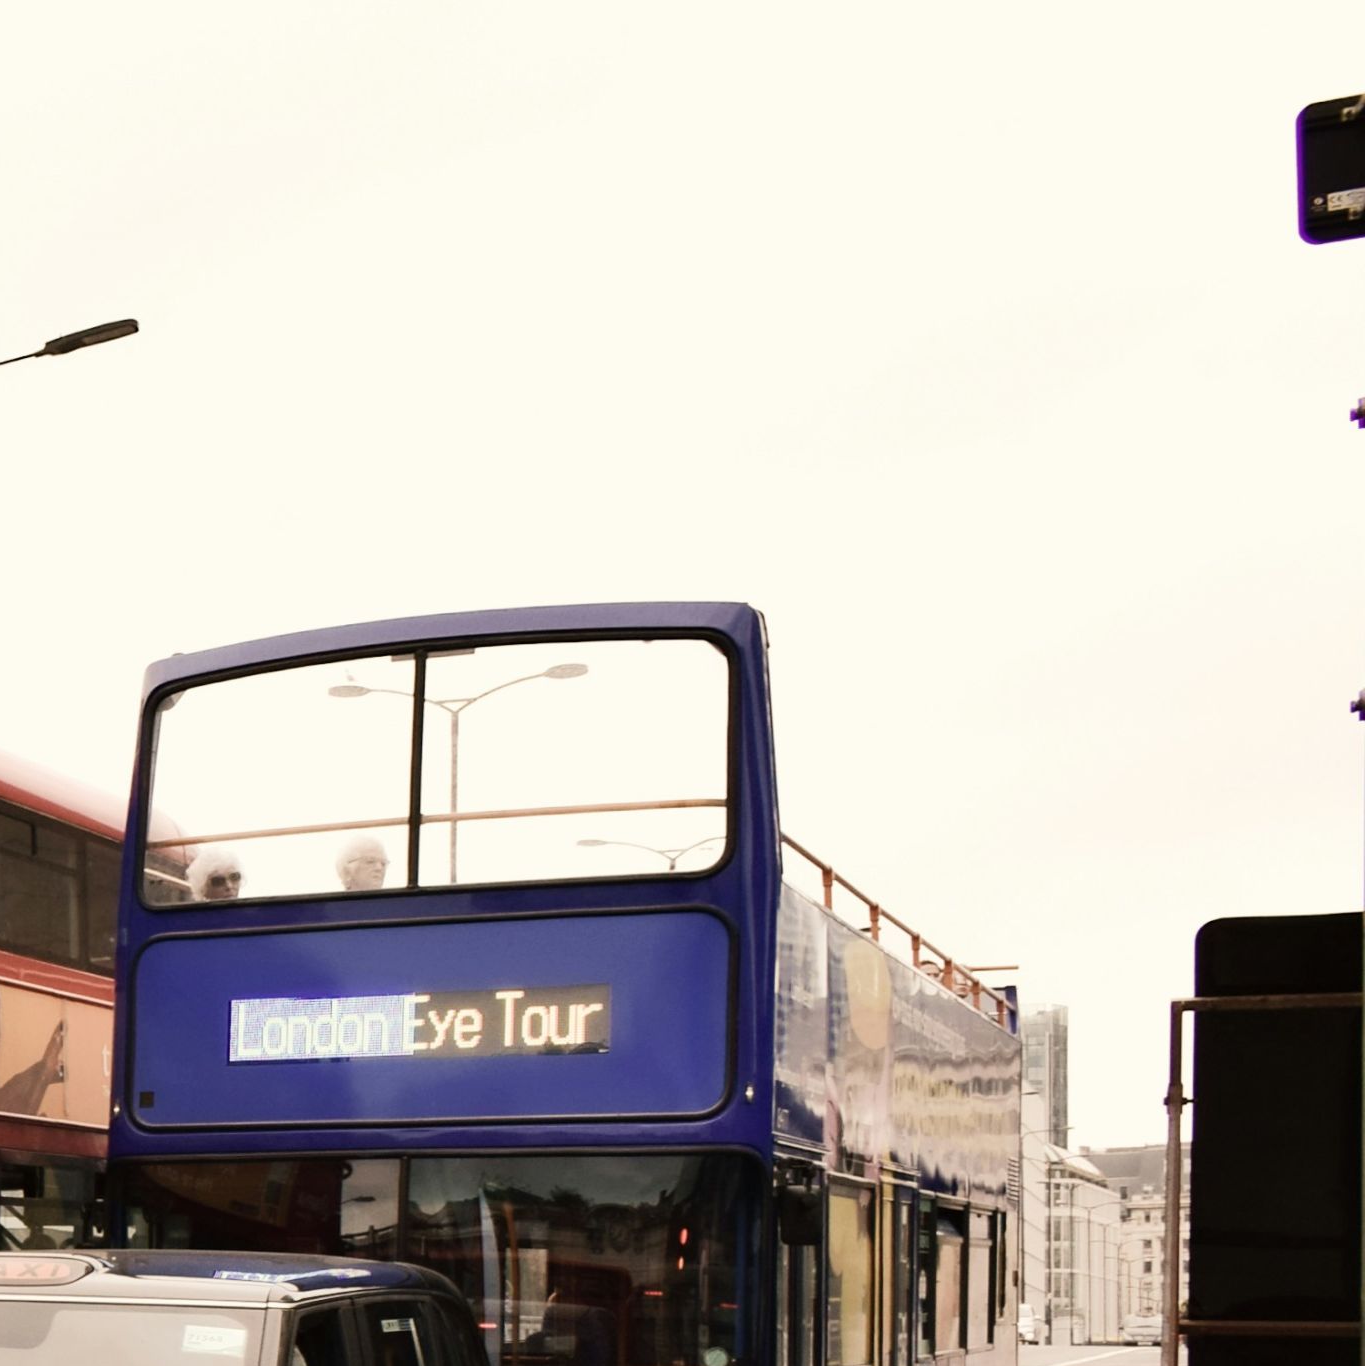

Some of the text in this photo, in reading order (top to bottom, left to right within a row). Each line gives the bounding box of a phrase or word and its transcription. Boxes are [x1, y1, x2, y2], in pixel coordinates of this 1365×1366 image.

[237, 989, 604, 1055] London Eye Tour
